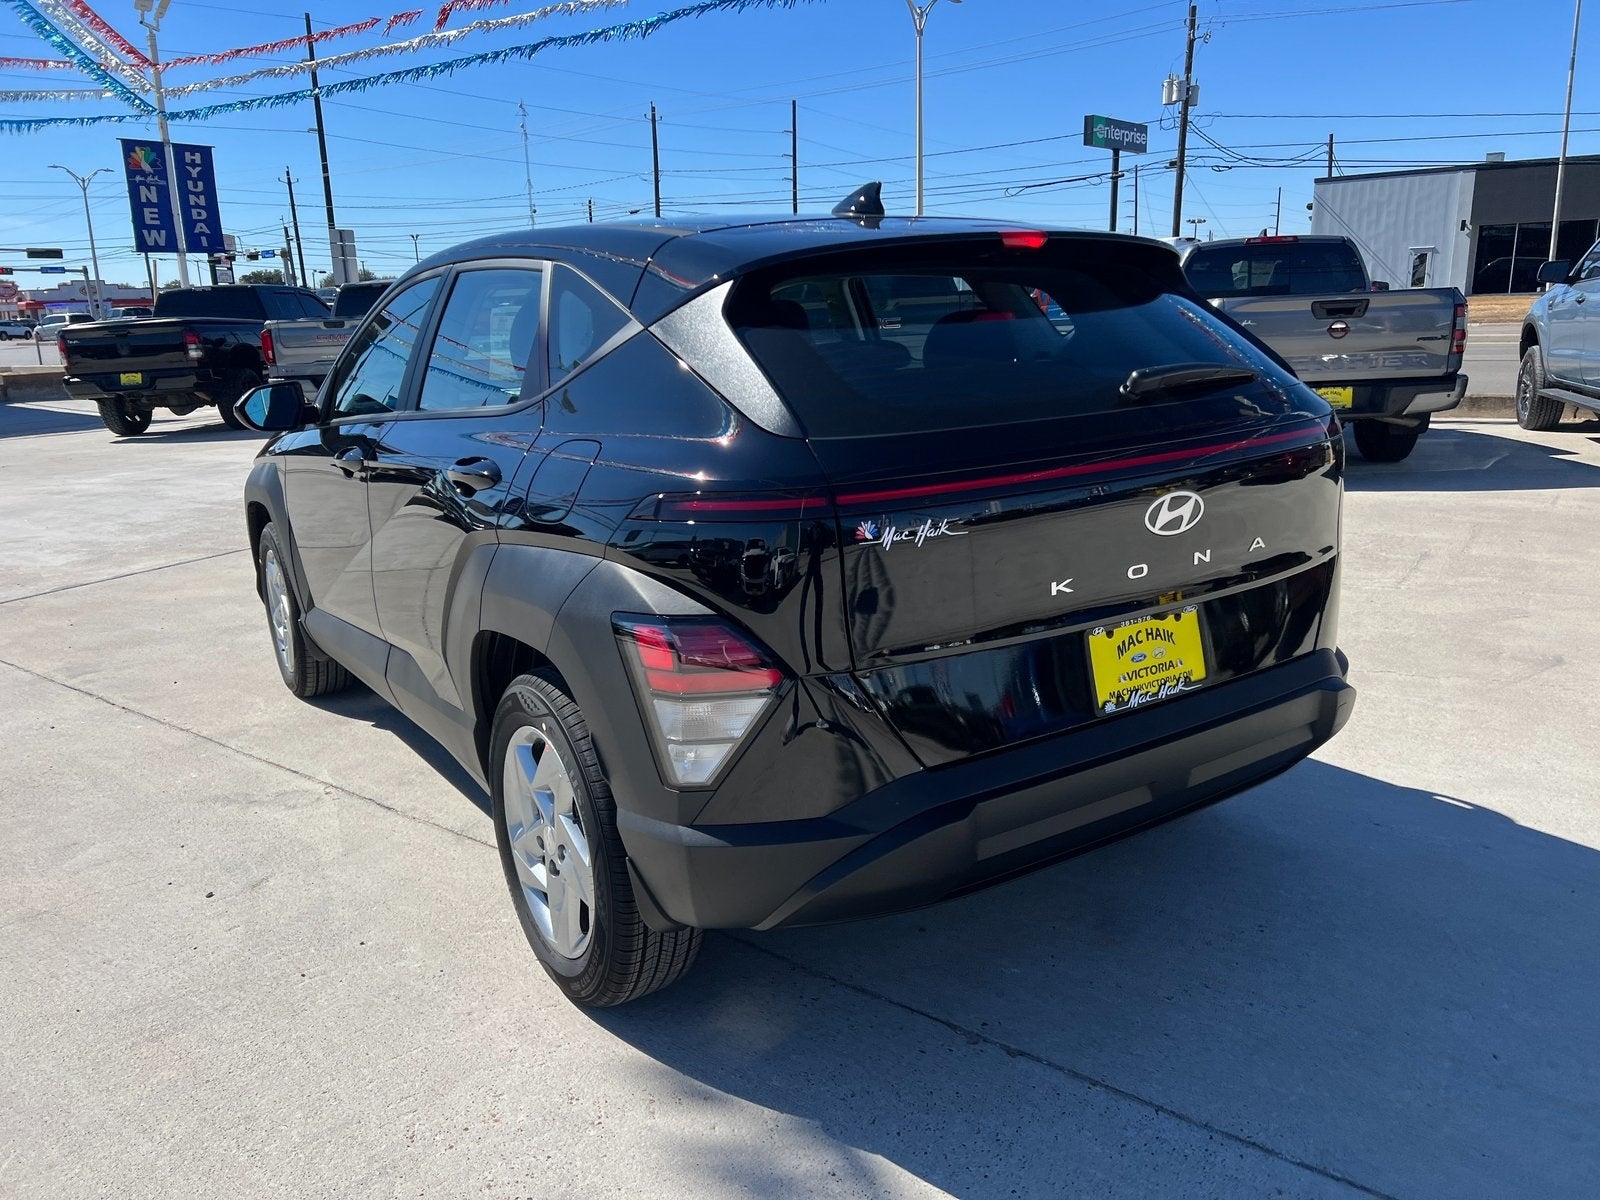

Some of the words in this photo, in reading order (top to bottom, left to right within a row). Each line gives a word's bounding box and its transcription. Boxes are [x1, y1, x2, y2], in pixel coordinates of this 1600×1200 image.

[1096, 123, 1147, 146] enterprise
[184, 151, 211, 247] HYUNDAI
[139, 185, 167, 247] NEW
[874, 526, 914, 551] Mac
[915, 518, 962, 547] Haik
[1051, 536, 1266, 596] KONA
[1117, 630, 1143, 660] MAC
[1145, 627, 1176, 645] HAIK
[1126, 660, 1176, 682] VICTORIA
[1121, 690, 1157, 709] Mac
[1158, 679, 1197, 699] Haik
